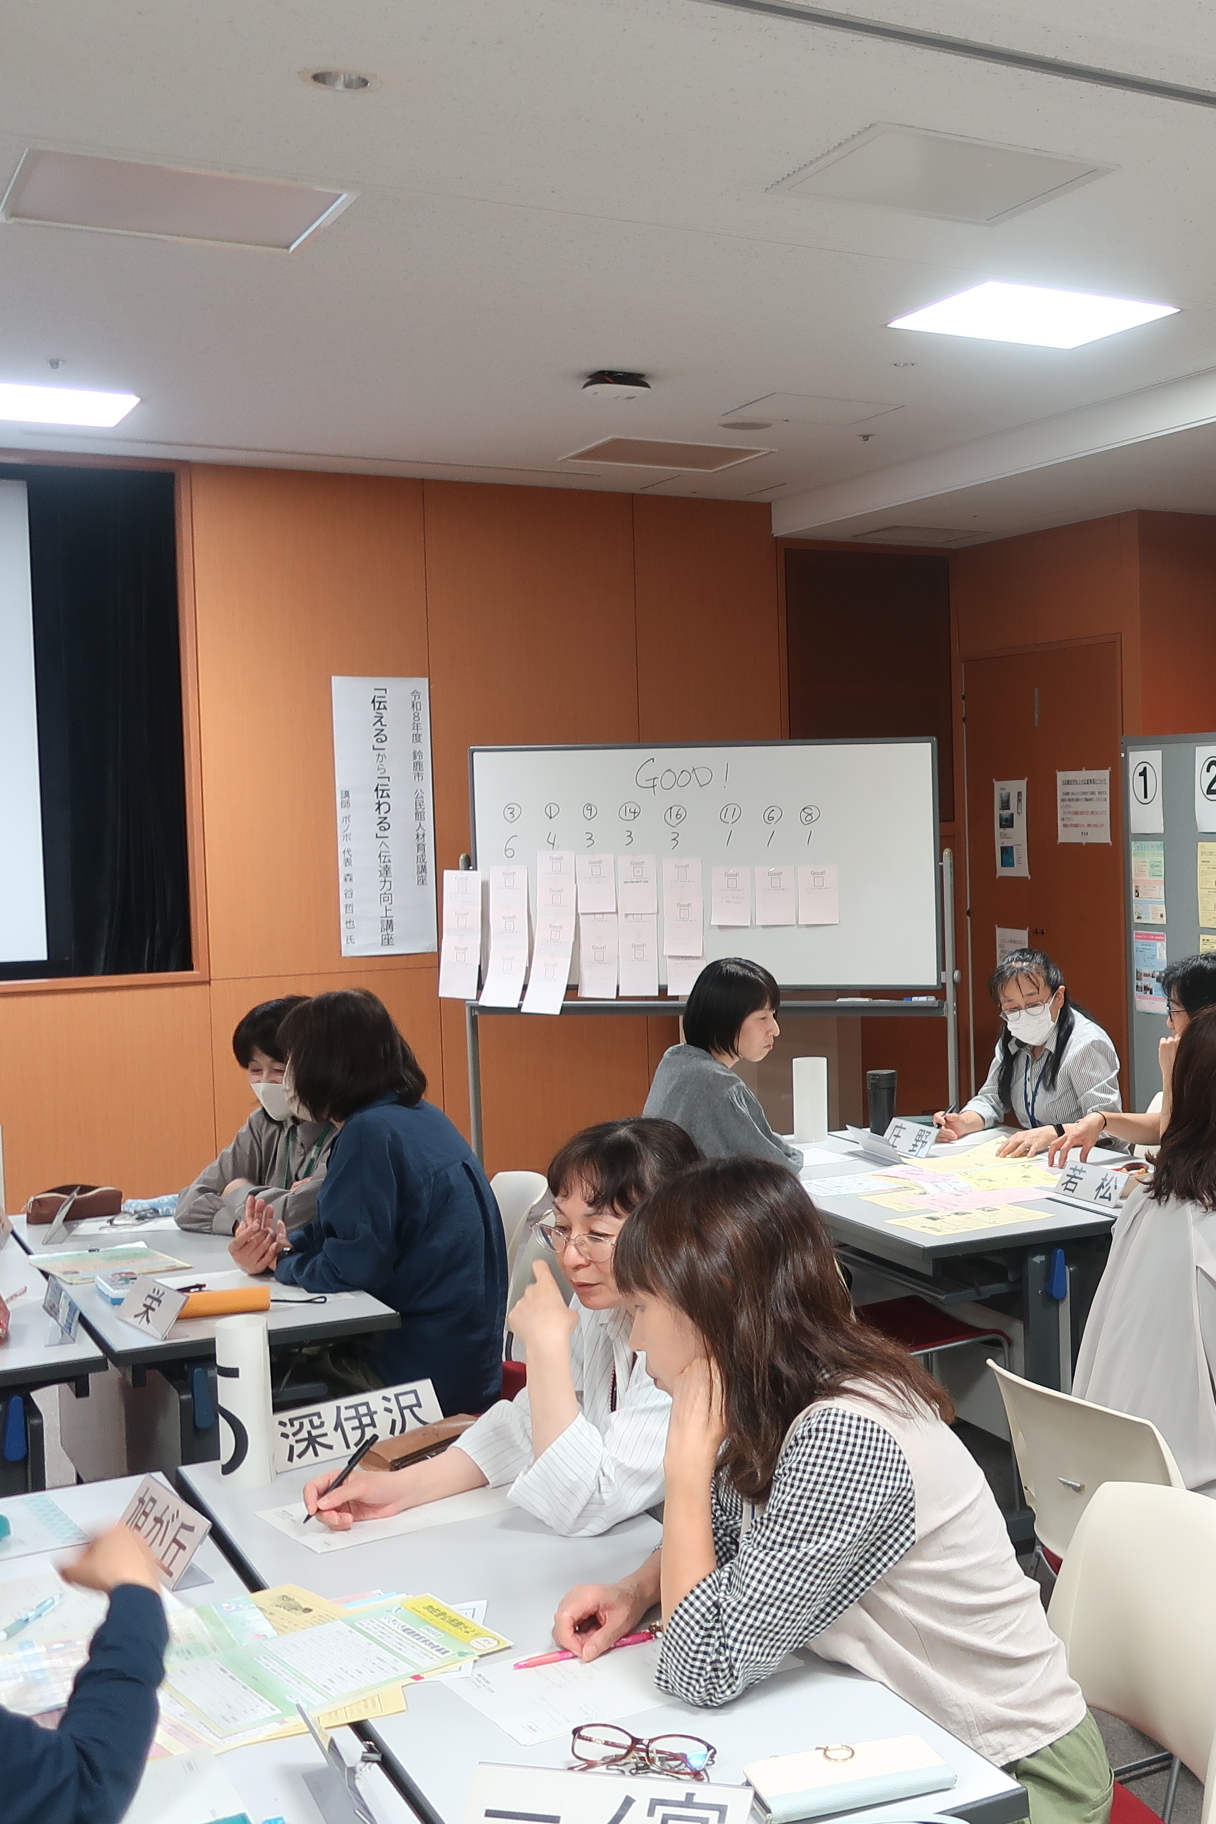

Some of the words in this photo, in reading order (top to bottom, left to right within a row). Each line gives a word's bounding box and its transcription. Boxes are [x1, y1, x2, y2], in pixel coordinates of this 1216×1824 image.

[412, 750, 424, 782] 鈴鹿市
[414, 789, 428, 886] 公民館人材育成講座
[504, 834, 518, 858] 6
[585, 831, 595, 848] 3
[625, 830, 634, 846] 3
[671, 831, 680, 850] 3
[888, 1123, 931, 1157] 庄野
[1061, 1165, 1118, 1202] 若松
[133, 1287, 165, 1325] 栄
[277, 1388, 432, 1464] 深伊沢
